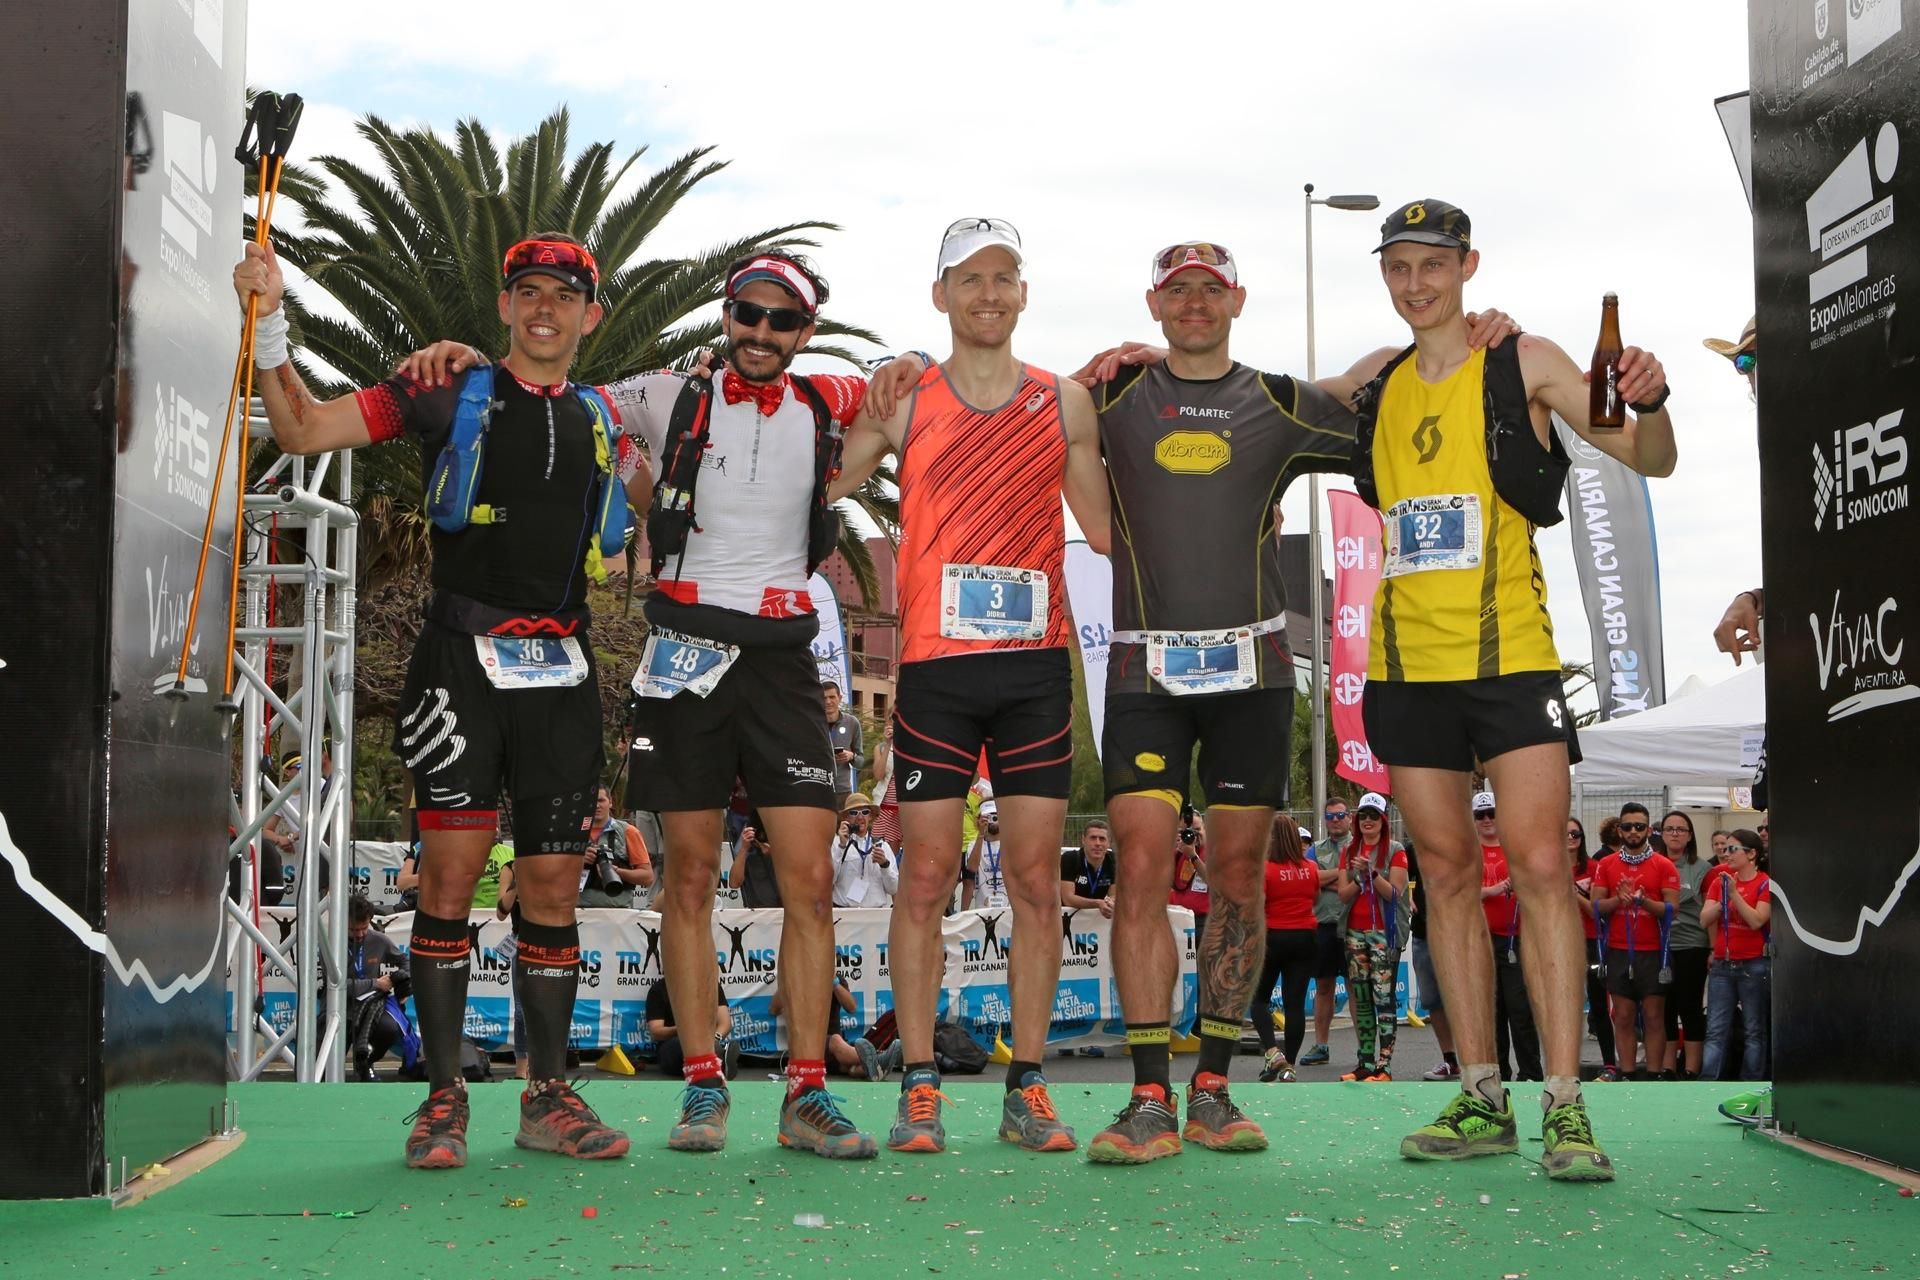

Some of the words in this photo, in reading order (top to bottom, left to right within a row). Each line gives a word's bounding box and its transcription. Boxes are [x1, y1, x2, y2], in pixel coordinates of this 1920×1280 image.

[1805, 45, 1829, 71] Cabildo
[1830, 37, 1839, 53] de
[1802, 71, 1818, 89] Gran
[1819, 51, 1844, 77] Canaria
[1824, 228, 1850, 252] LOPESAN
[1851, 217, 1869, 237] HOTEL
[1870, 204, 1891, 225] GROUP
[1810, 275, 1896, 333] ExpoMeloneras
[1839, 322, 1853, 337] GRAN
[1853, 313, 1875, 332] CANARIA
[1179, 406, 1231, 419] POLARTEC
[1848, 484, 1908, 523] SONOCOM
[1415, 513, 1442, 540] 32
[990, 583, 1004, 609] 3
[518, 638, 545, 662] 36
[670, 646, 700, 672] 48
[1196, 650, 1205, 668] 1
[670, 670, 688, 681] DIEGO
[1855, 670, 1906, 692] AVENTURA
[1062, 957, 1087, 967] ANARIA
[617, 977, 639, 986] GRAN
[983, 992, 998, 1002] UNA
[1059, 988, 1072, 997] UNA
[274, 1001, 290, 1009] UNA
[982, 1001, 1005, 1014] META
[1057, 997, 1080, 1010] META
[1065, 1001, 1095, 1019] SUEÑO
[464, 1020, 501, 1038] SUEÑO
[734, 1019, 769, 1039] SUEÑO
